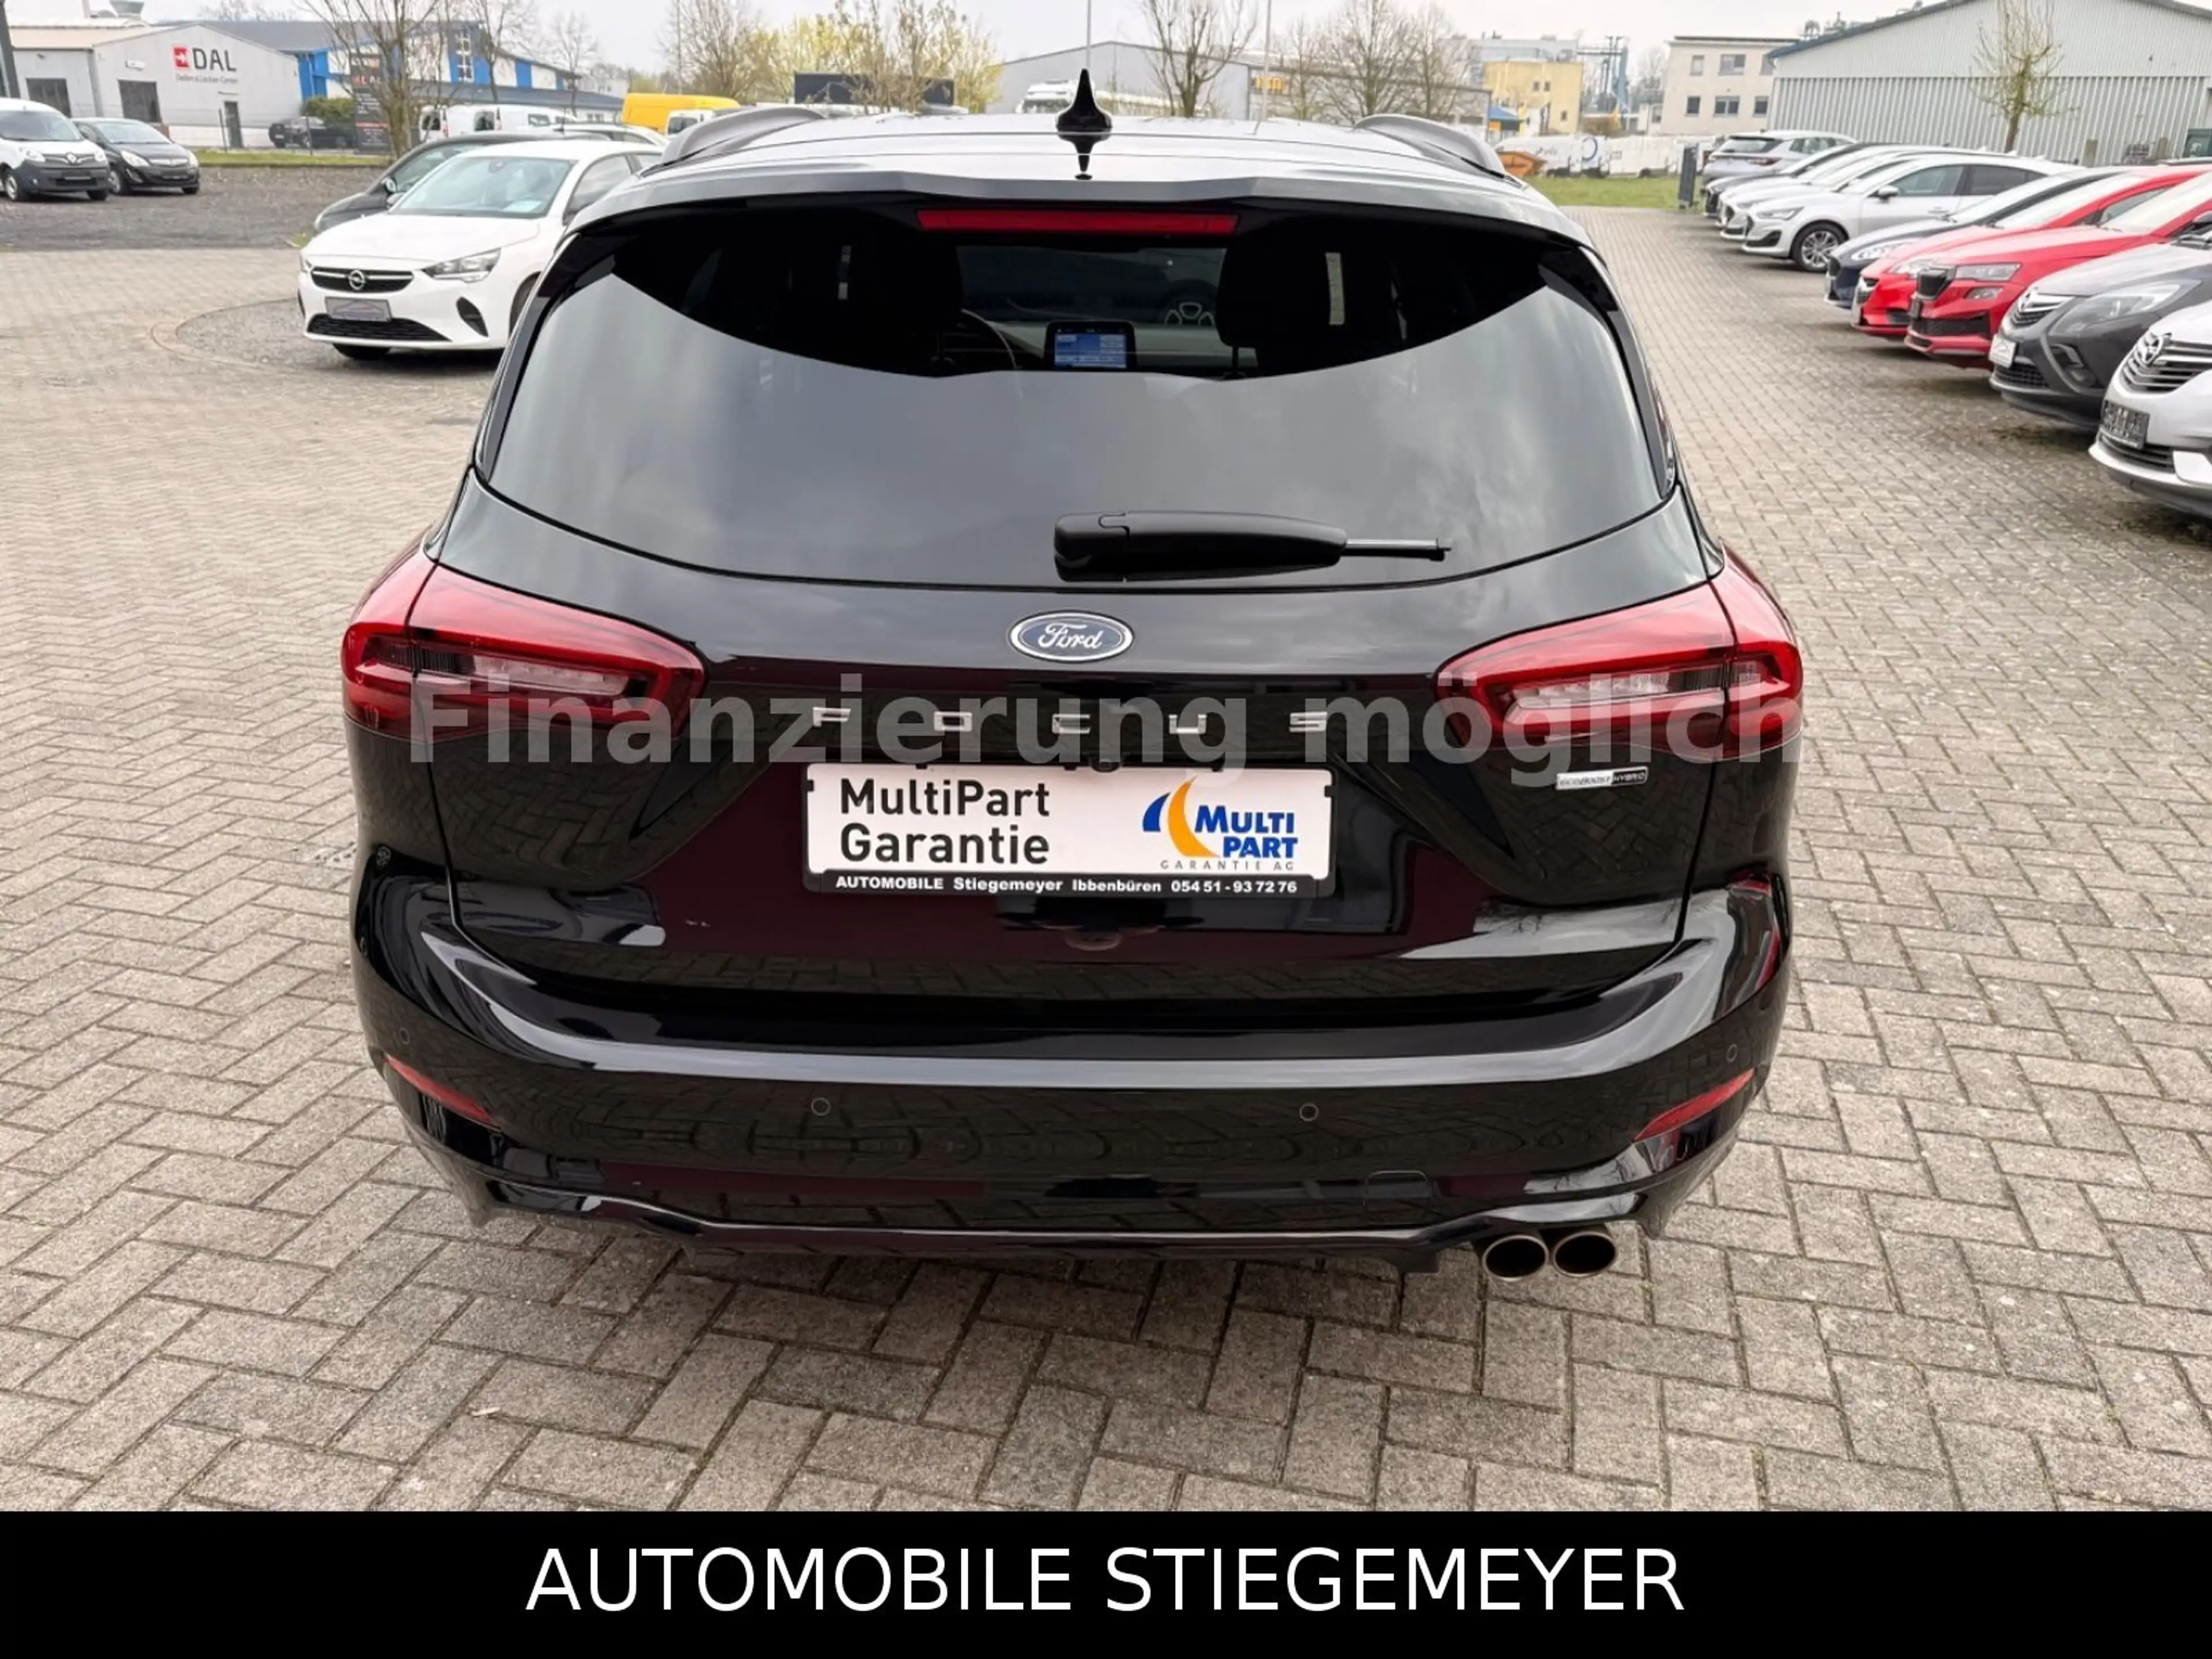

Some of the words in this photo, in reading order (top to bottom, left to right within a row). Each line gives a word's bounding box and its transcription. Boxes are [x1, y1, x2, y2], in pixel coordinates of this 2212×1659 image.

[192, 48, 237, 71] DAL
[1038, 622, 1104, 649] Ford
[812, 706, 1328, 734] FOCUS
[841, 778, 1050, 816] MultiPart
[841, 822, 1049, 864] Garantie
[1223, 836, 1298, 858] PART
[1160, 860, 1260, 870] GARANTIE
[1273, 861, 1294, 870] AG
[836, 876, 944, 890] AUTOMOBILE
[953, 877, 1064, 893] Stiegemeyer
[1072, 879, 1161, 892] Ibbenbüren
